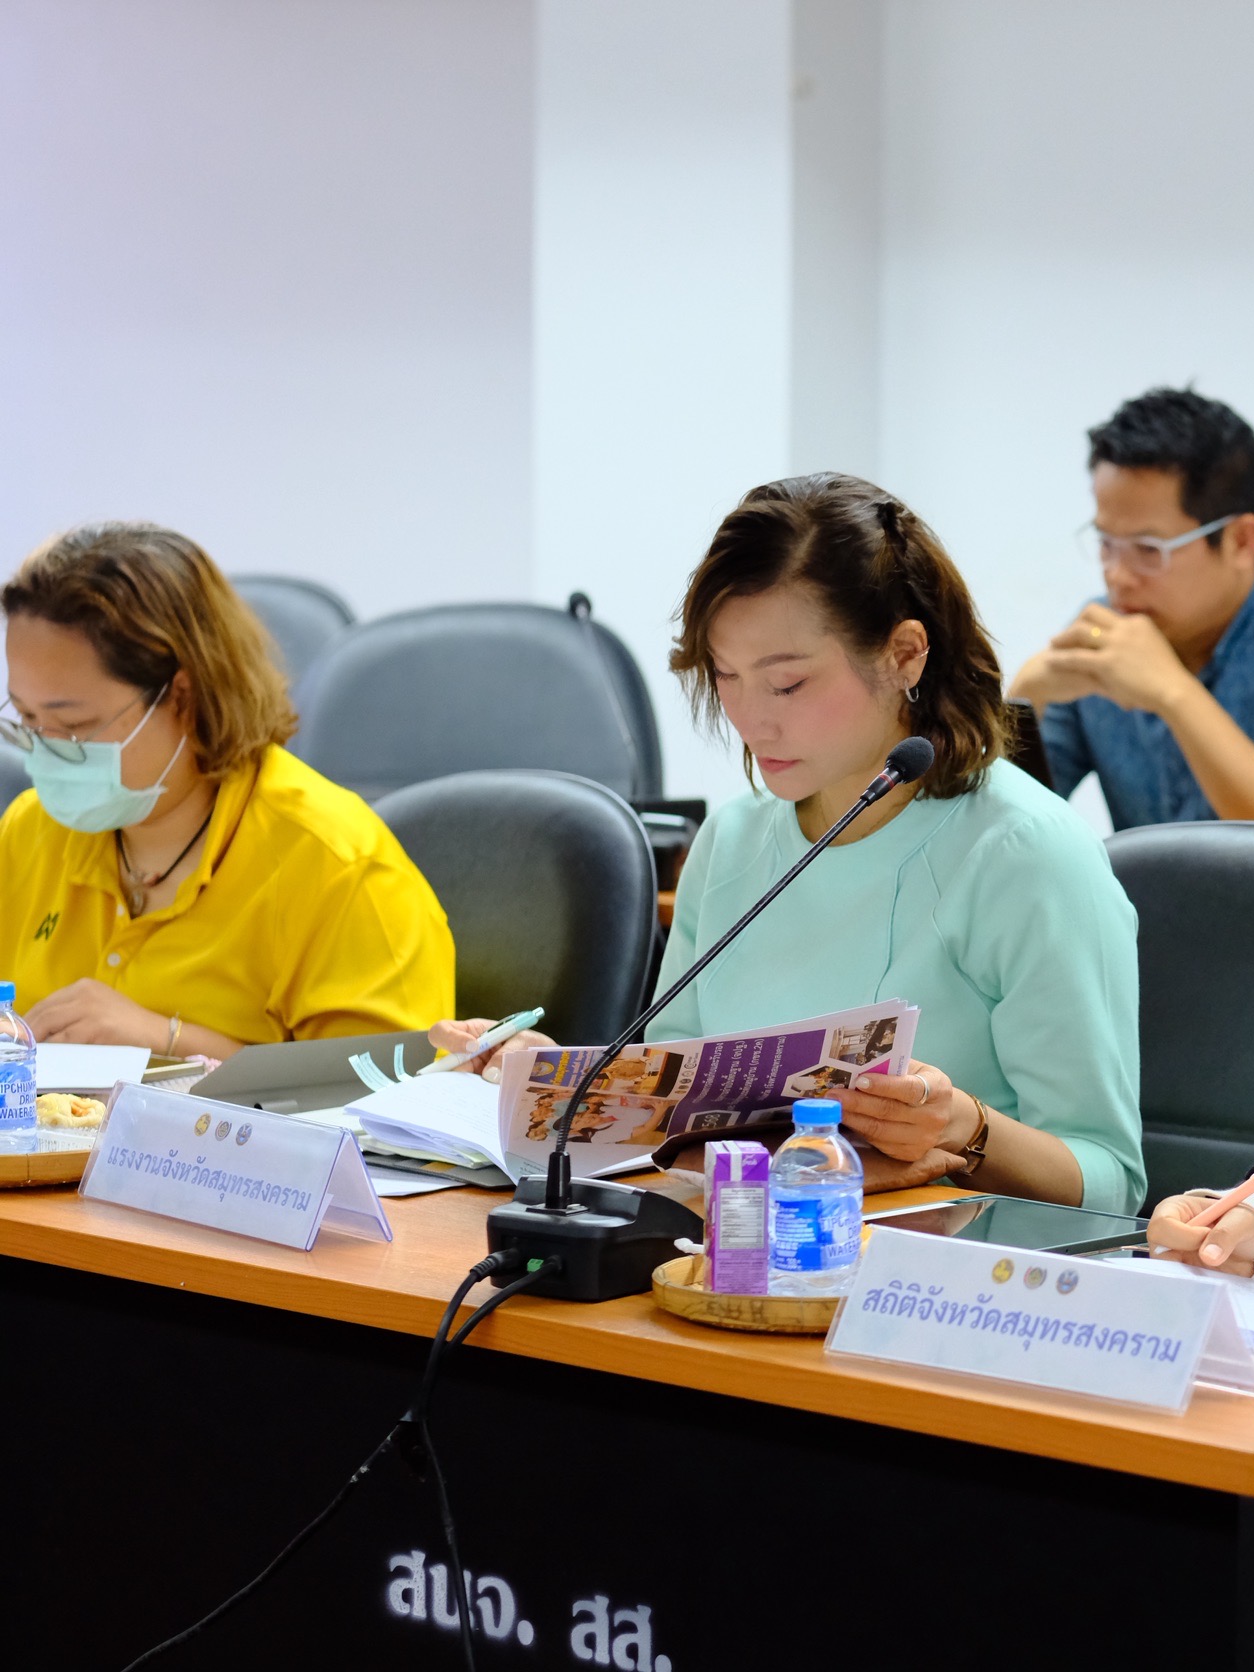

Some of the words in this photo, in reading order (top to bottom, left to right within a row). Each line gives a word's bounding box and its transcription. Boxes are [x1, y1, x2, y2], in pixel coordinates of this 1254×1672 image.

[701, 1113, 721, 1128] 568
[107, 1143, 312, 1213] แรงงานจังหวัดสมุทรสงคราม
[861, 1278, 1182, 1364] สถิติจังหวัดสมุทรสงคราม
[570, 1594, 672, 1672] สส.
